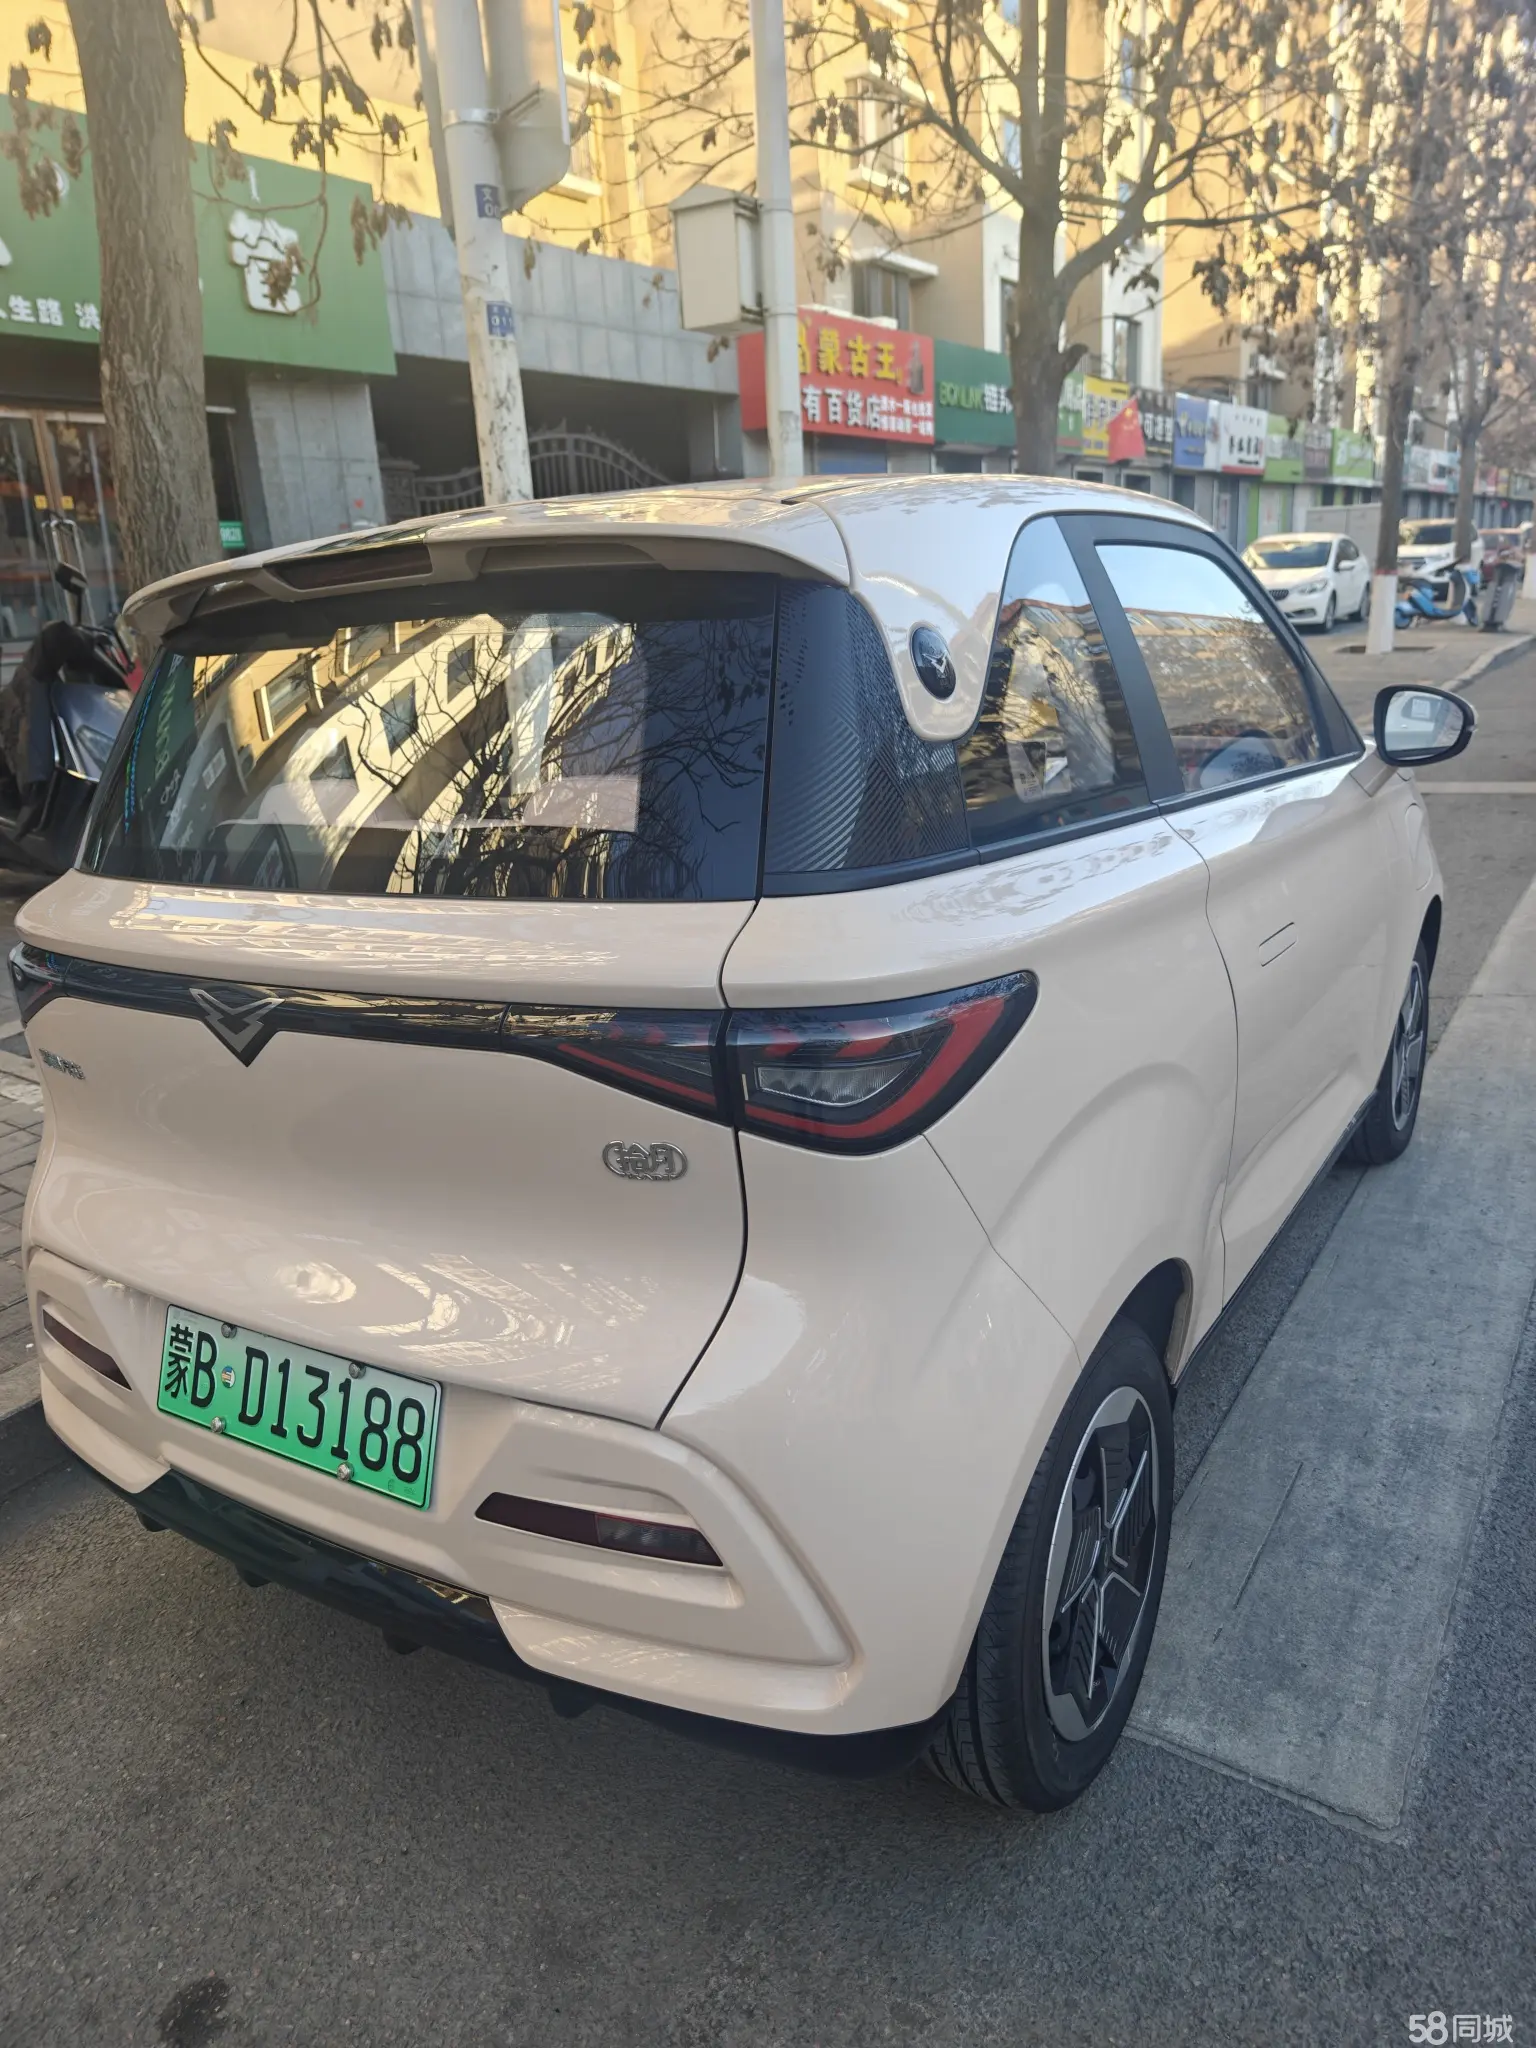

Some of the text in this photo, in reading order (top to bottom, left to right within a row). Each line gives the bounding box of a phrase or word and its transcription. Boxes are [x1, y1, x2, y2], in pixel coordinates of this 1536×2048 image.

[0, 293, 64, 327] 生路
[802, 384, 880, 429] 有百货店
